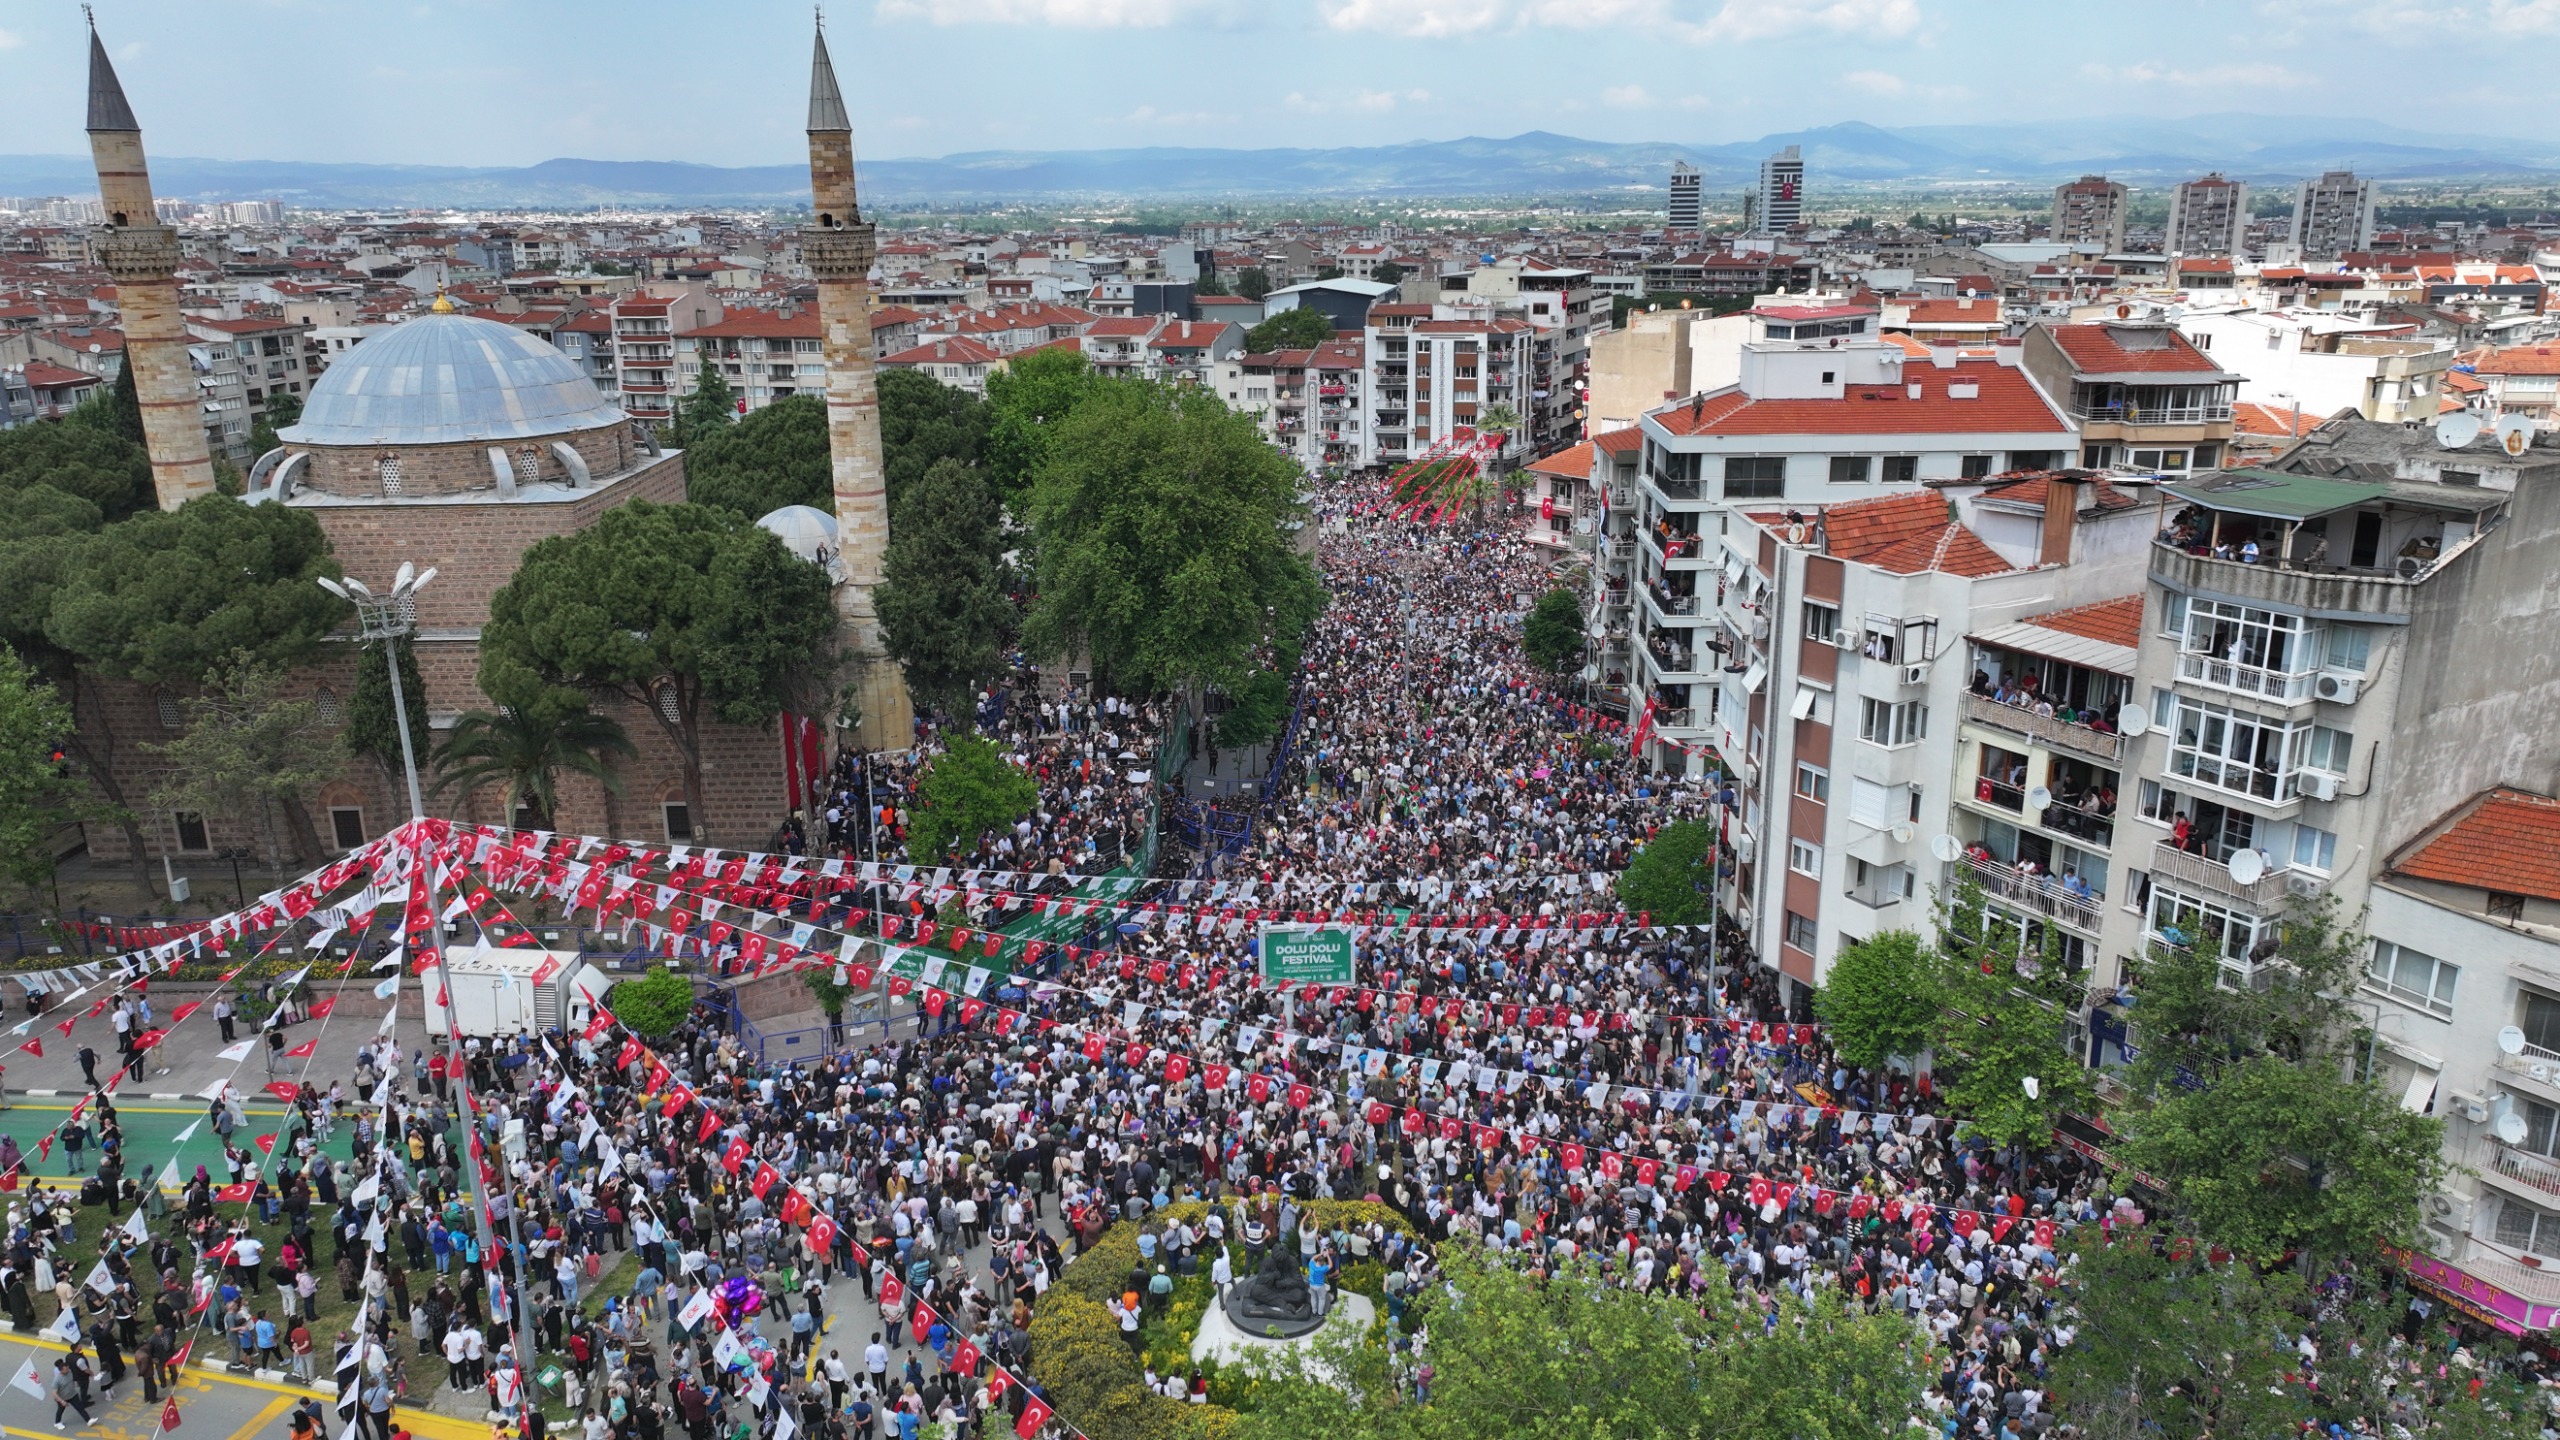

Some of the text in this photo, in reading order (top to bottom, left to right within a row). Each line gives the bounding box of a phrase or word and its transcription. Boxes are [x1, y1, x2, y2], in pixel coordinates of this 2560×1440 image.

[1275, 943, 1341, 955] DOLU DOLU
[1282, 953, 1335, 965] FESTİVAL
[2435, 1290, 2463, 1310] SANAT
[2464, 1304, 2496, 1327] GALERİ
